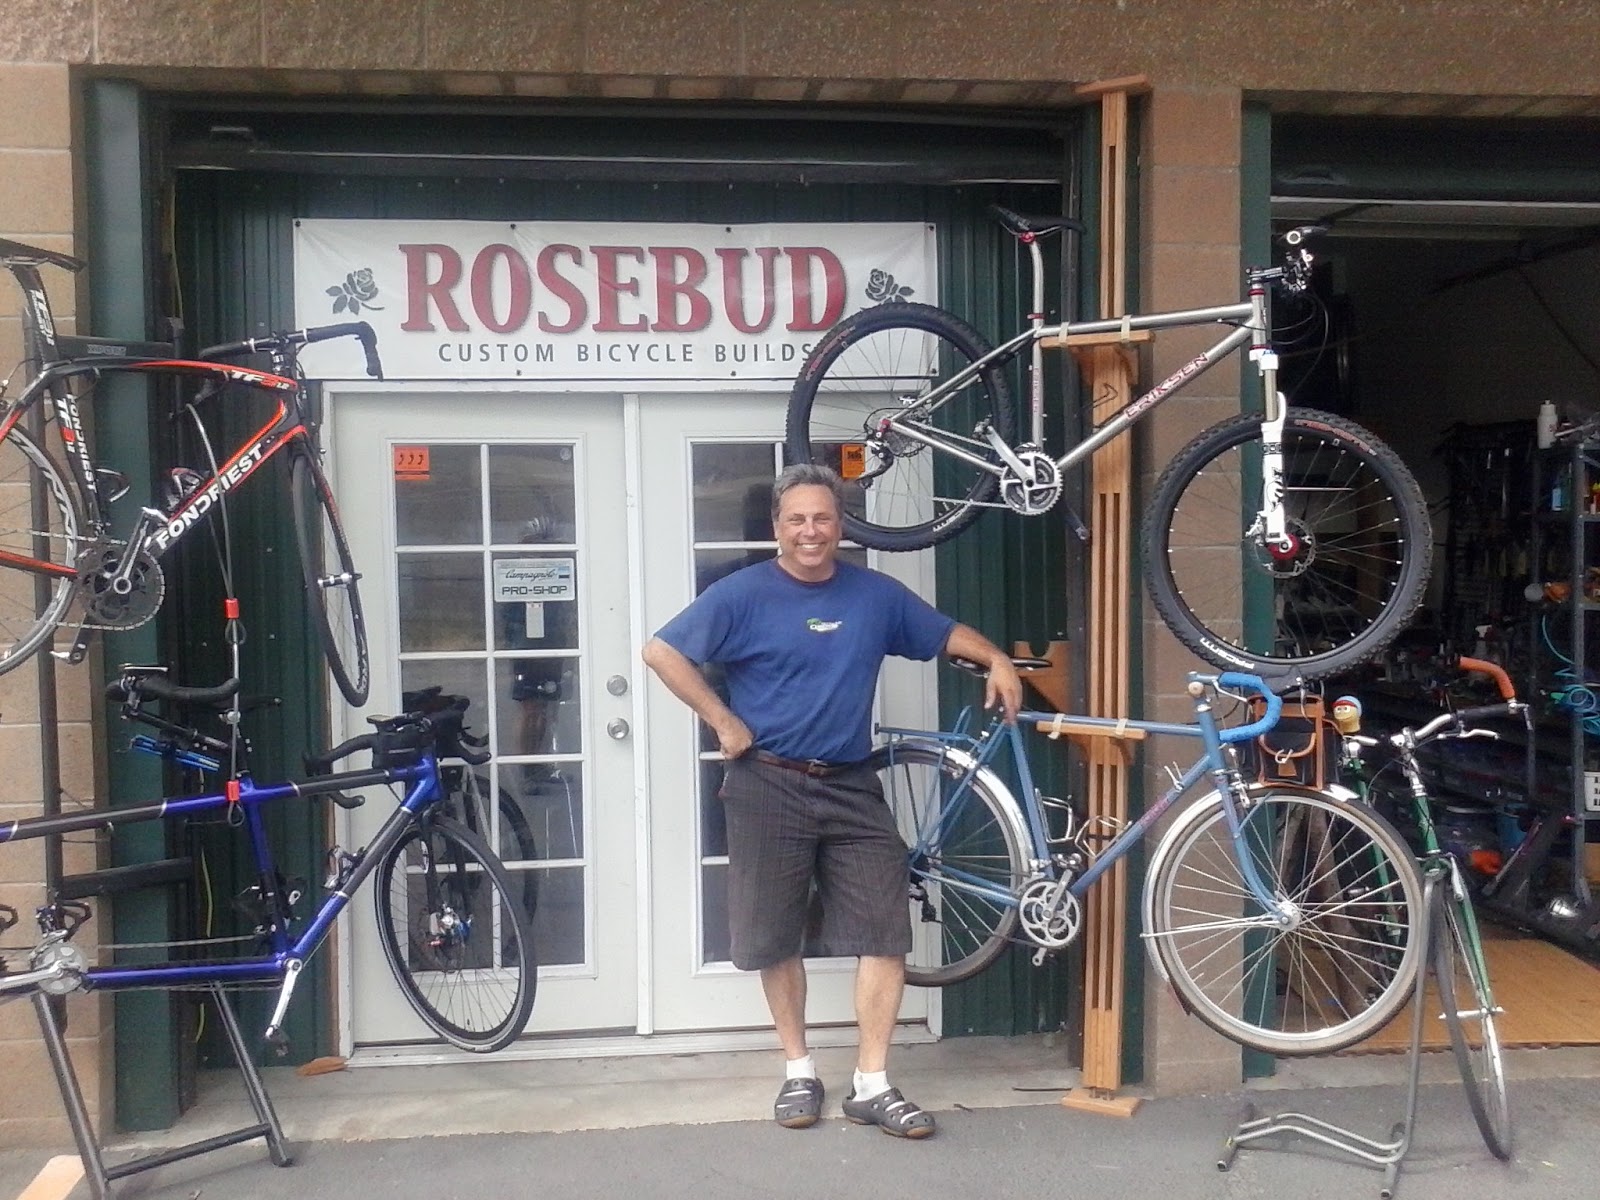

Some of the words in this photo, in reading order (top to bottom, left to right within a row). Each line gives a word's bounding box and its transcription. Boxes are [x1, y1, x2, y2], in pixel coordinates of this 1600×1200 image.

[399, 243, 849, 335] ROSEBUD
[438, 343, 556, 363] CUSTOM
[576, 343, 694, 363] BICYCLE
[715, 344, 814, 364] BUILDS
[1125, 352, 1209, 419] ERIKSEN
[66, 393, 97, 493] FONDRIEST
[155, 442, 263, 550] FONDRIEST
[502, 585, 568, 596] PRO-SHOP
[505, 569, 557, 582] Campagnolo
